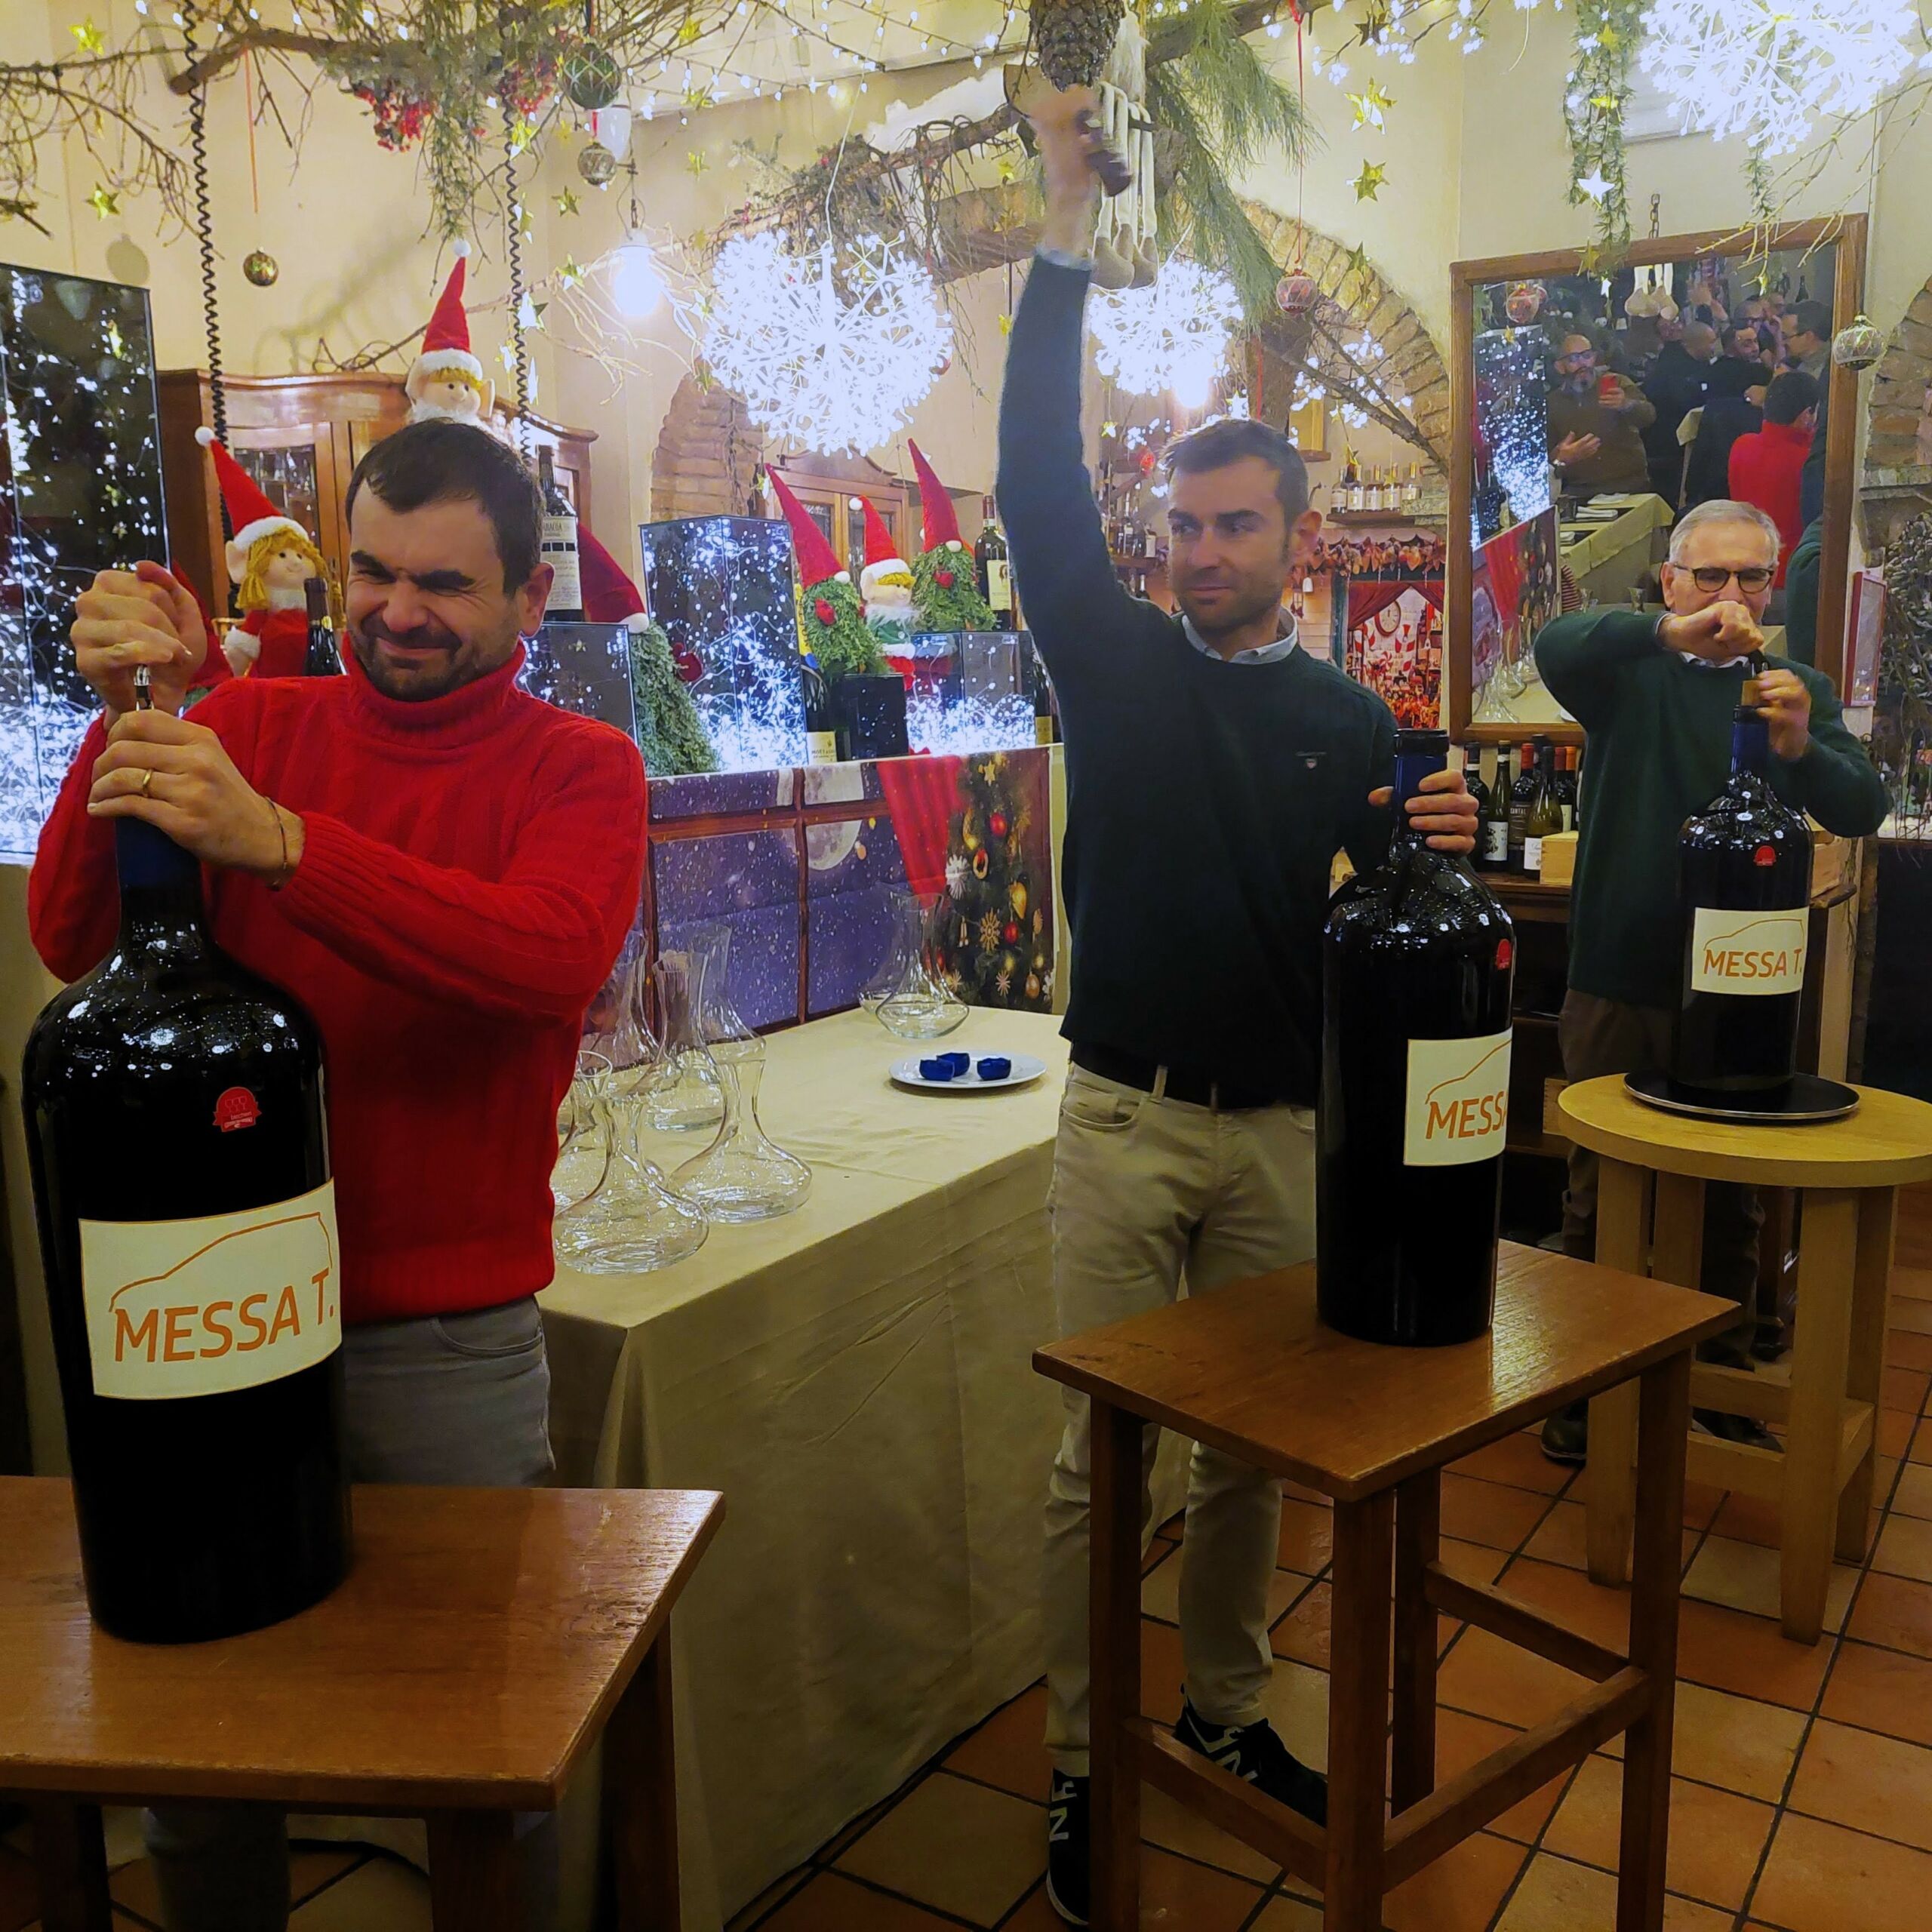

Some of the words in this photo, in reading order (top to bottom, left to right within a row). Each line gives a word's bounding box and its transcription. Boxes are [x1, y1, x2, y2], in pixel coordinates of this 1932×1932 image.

[1703, 949, 1787, 978] MESSA
[114, 1284, 300, 1363] MESSA
[311, 1266, 334, 1325] T.
